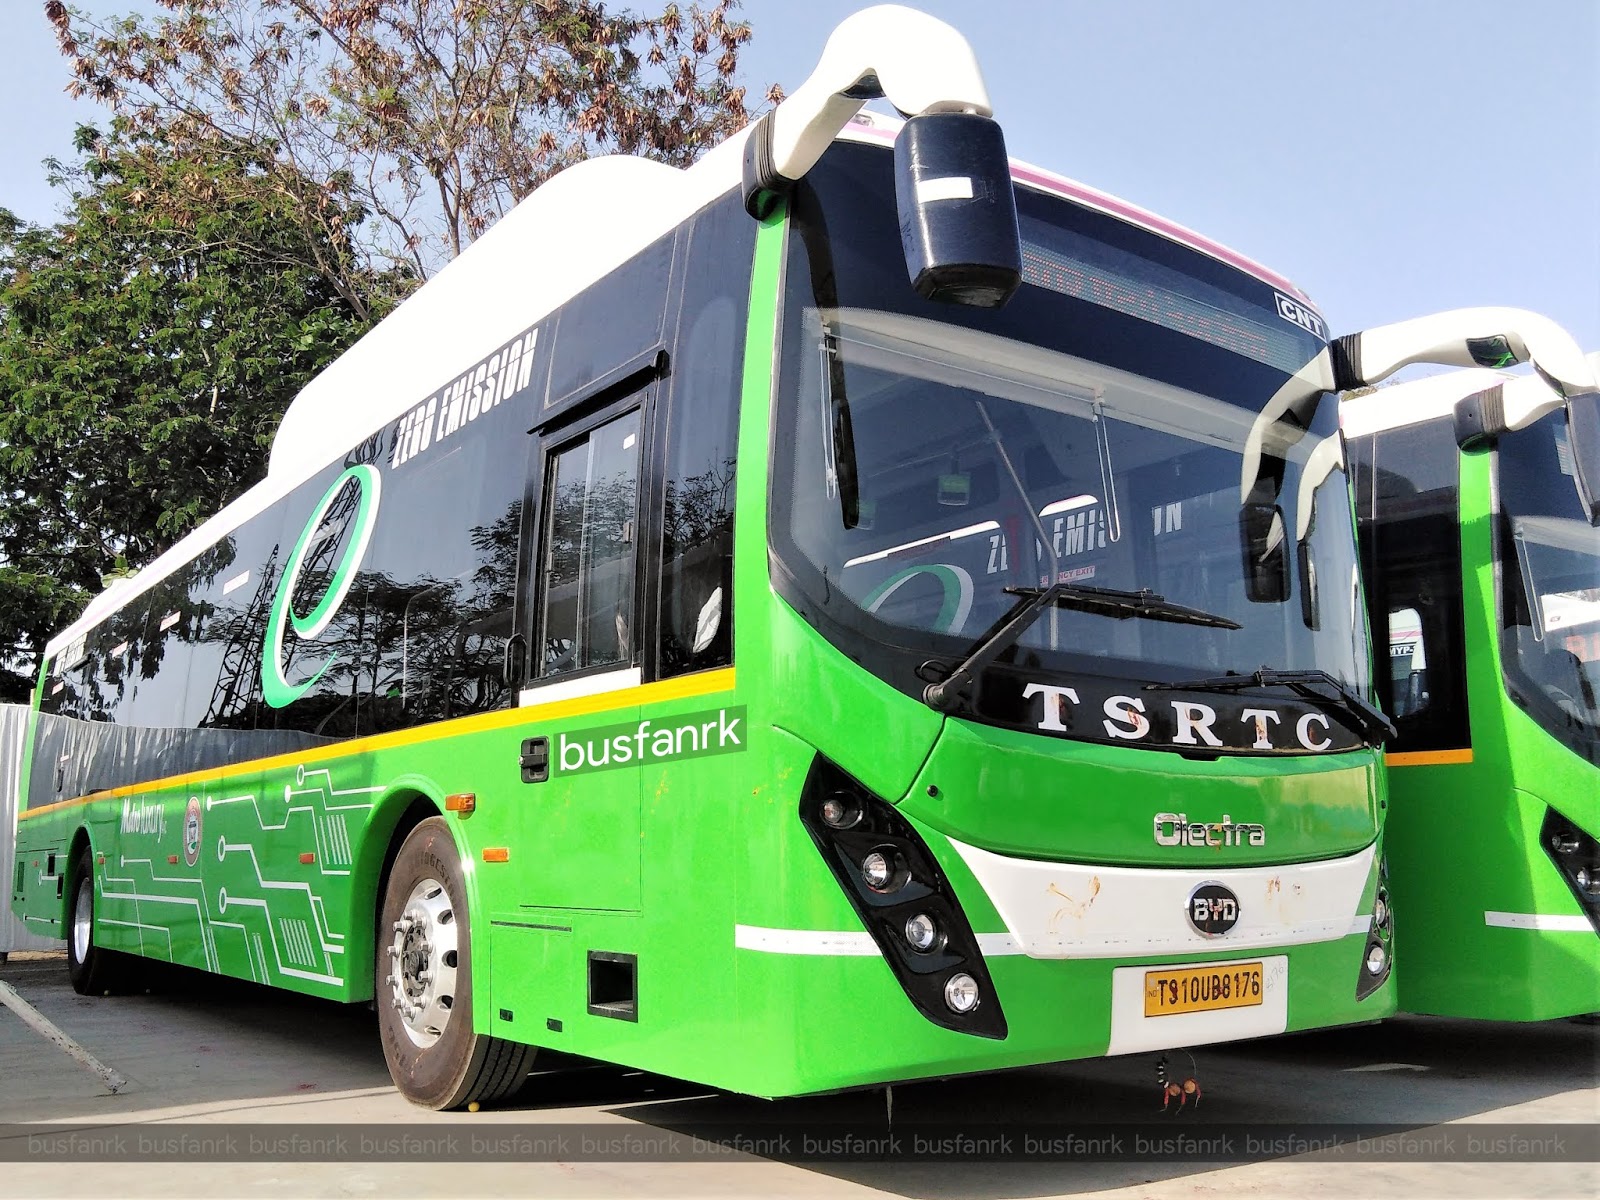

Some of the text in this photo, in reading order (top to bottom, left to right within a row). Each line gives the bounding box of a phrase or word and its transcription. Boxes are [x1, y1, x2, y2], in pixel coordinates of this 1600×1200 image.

[1280, 300, 1321, 335] CNT
[391, 328, 538, 470] ZERO EMISSION
[1154, 812, 1265, 846] Olectra
[1193, 898, 1236, 921] BYD
[1158, 971, 1260, 1006] TS10UB8176
